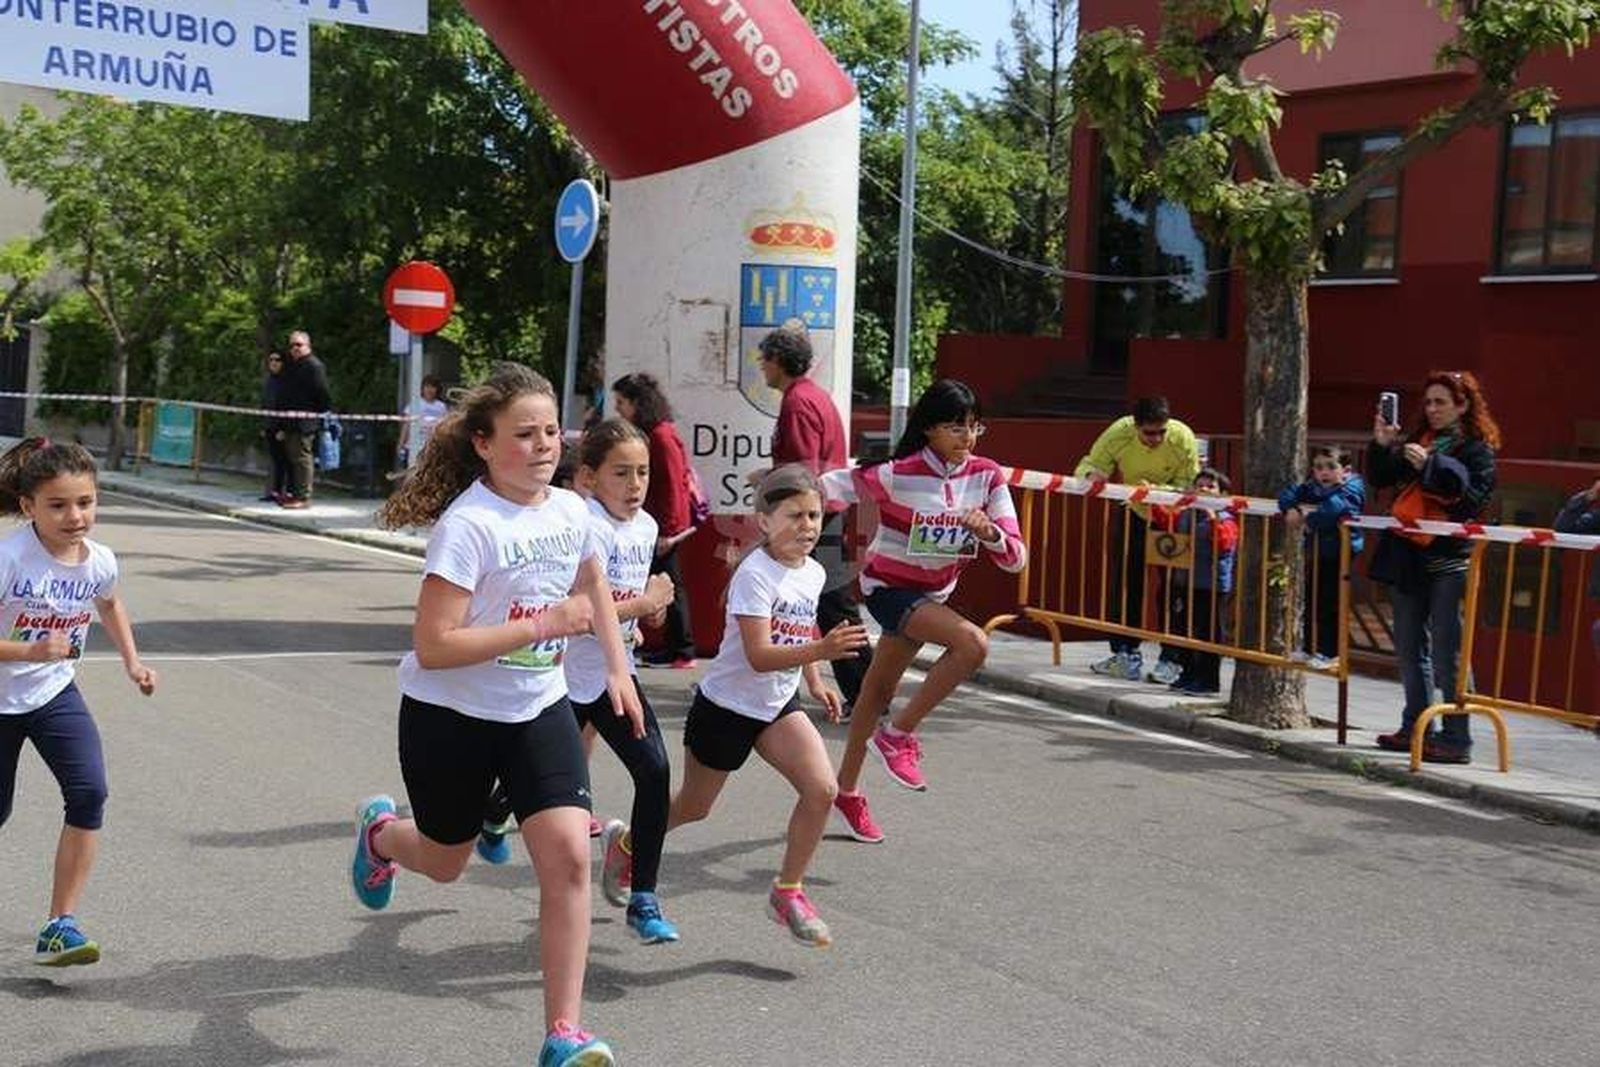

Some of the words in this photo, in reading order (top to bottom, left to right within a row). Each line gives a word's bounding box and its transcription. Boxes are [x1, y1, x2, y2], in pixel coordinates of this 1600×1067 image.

[0, 0, 236, 47] NTERRUBIO
[254, 26, 297, 57] DE
[704, 0, 799, 99] TROS
[43, 46, 214, 95] ARMUÑA
[13, 579, 34, 598] LA
